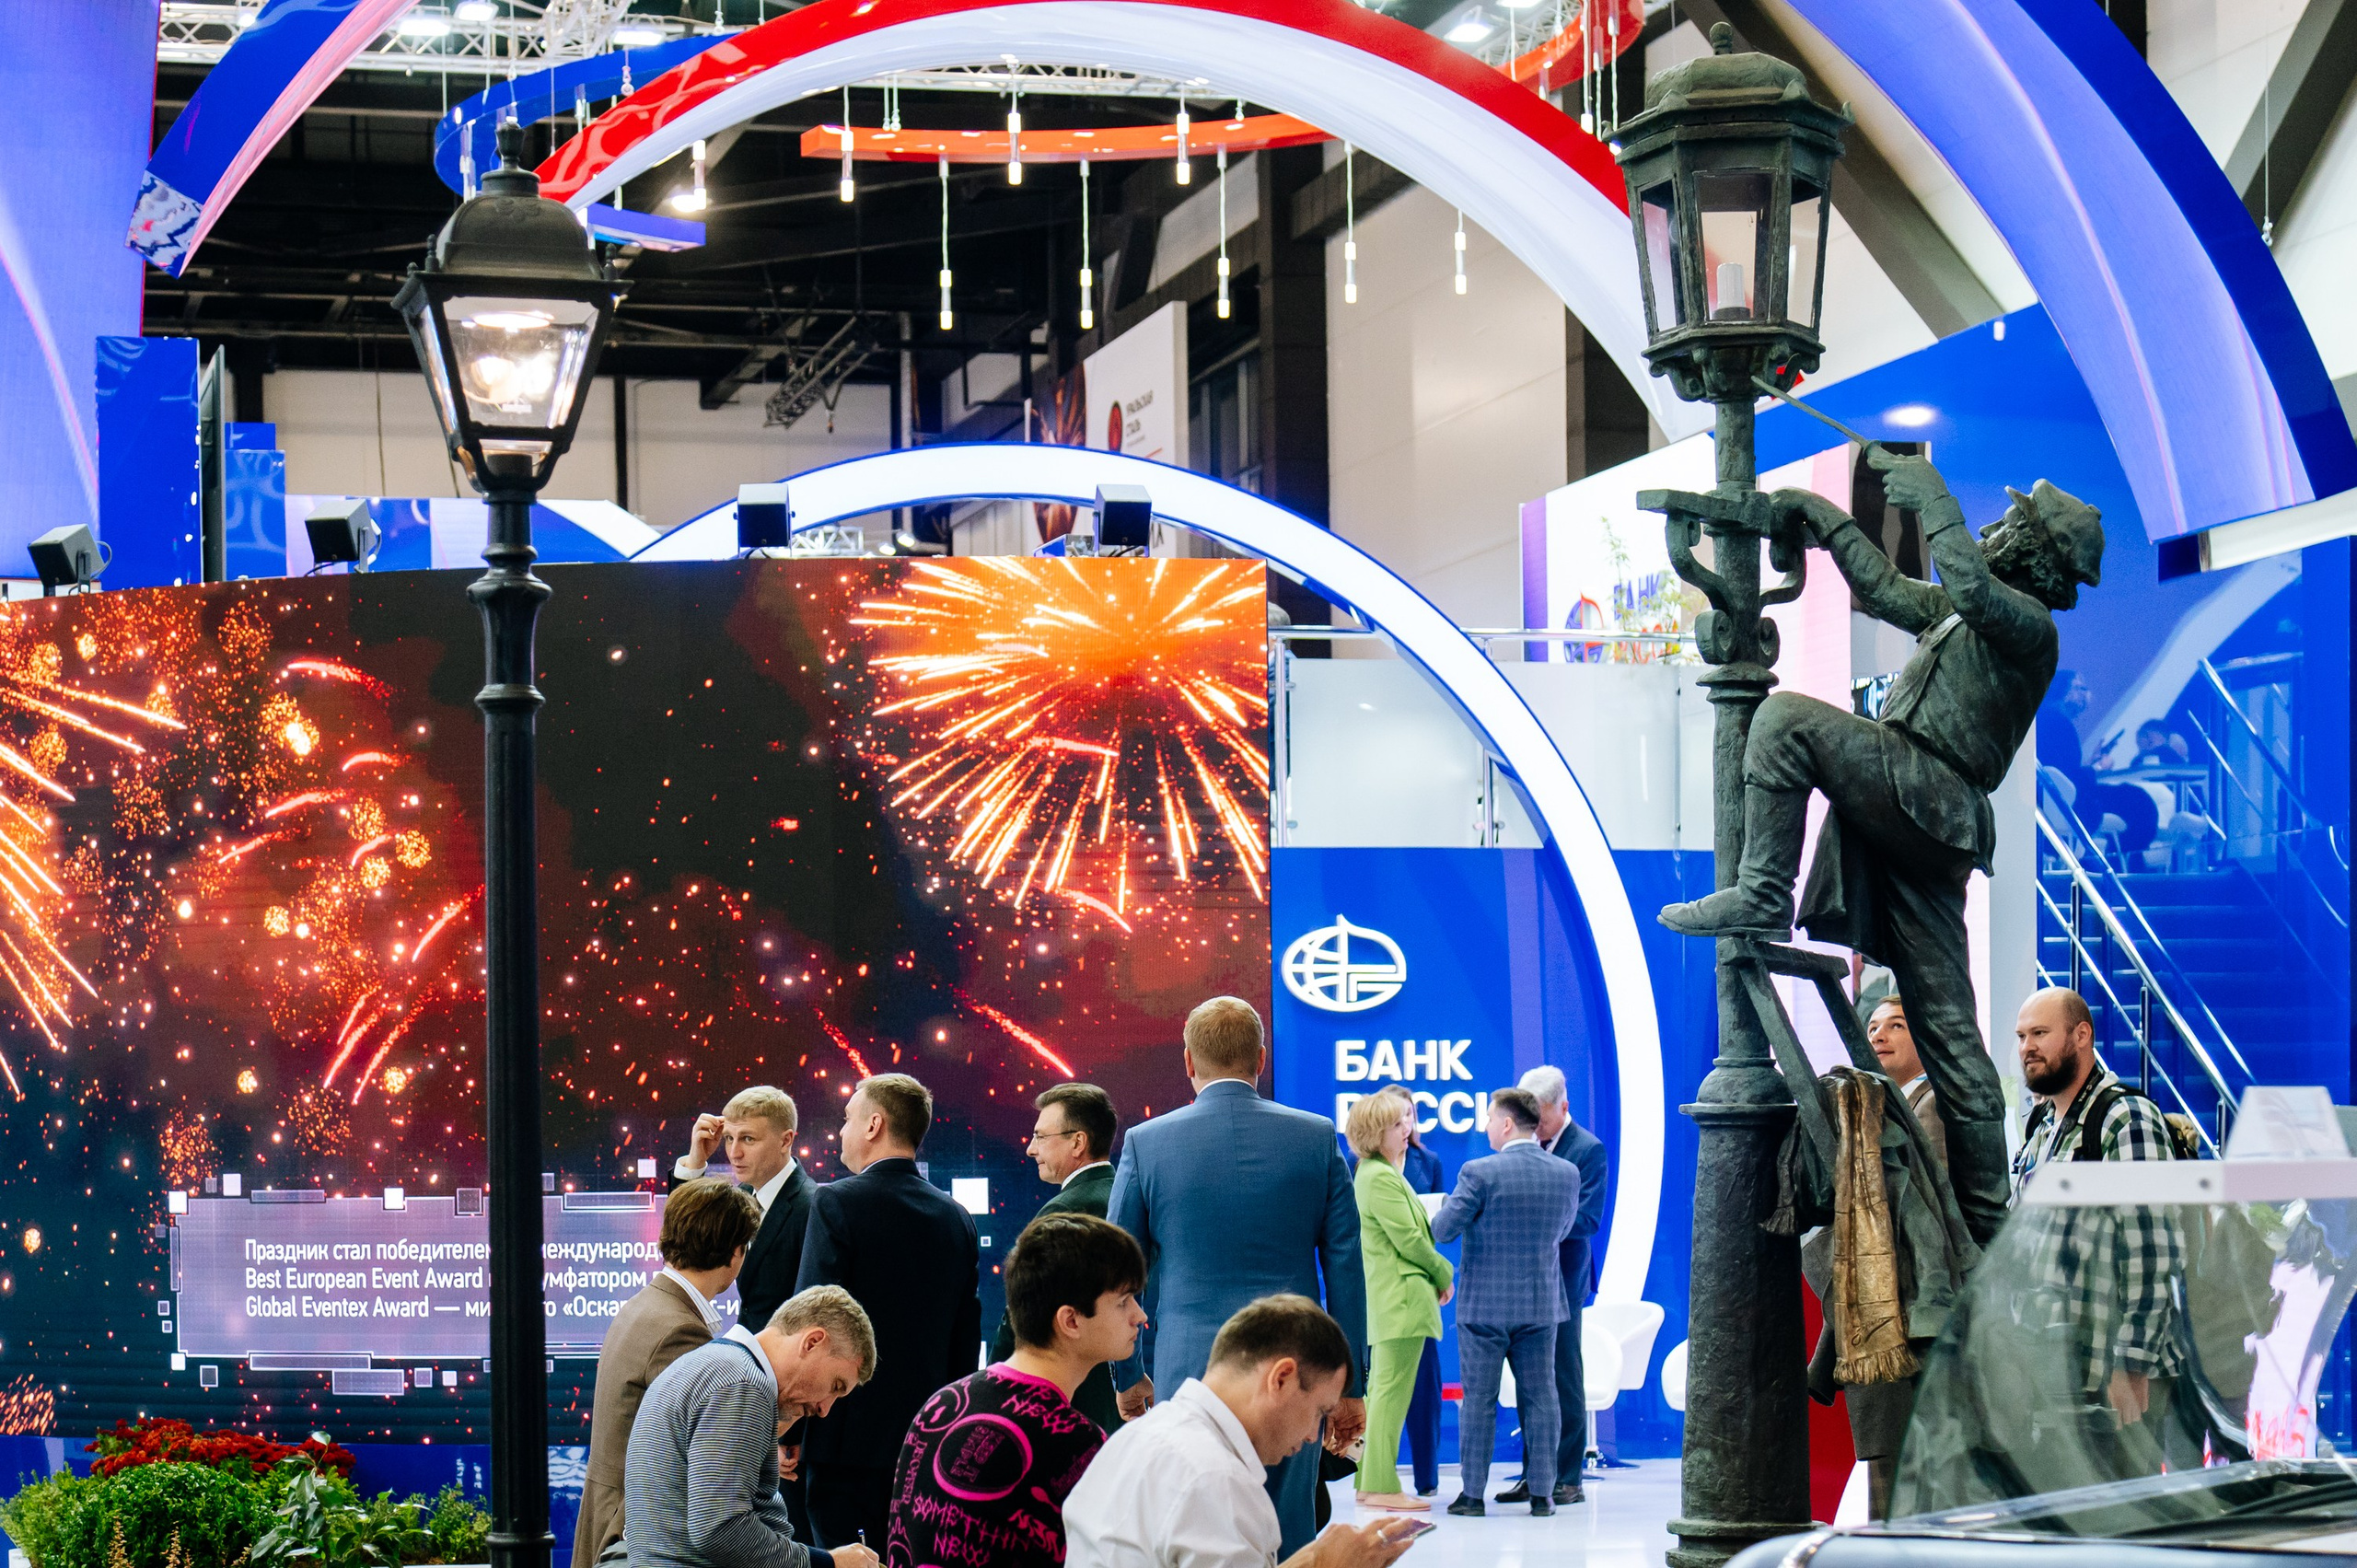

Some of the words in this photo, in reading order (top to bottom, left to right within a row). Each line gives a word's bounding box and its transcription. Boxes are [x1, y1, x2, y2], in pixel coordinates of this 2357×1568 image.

[1335, 1039, 1473, 1082] БАНК
[245, 1238, 329, 1265] Праздник
[332, 1243, 371, 1260] стал
[542, 1241, 663, 1264] еждународ
[245, 1267, 281, 1289] Best
[285, 1267, 366, 1294] European
[372, 1267, 419, 1289] Event
[424, 1267, 482, 1289] Award
[542, 1266, 647, 1293] умфатором
[246, 1295, 296, 1318] Global
[302, 1295, 368, 1318] Eventex
[373, 1295, 429, 1318] Award
